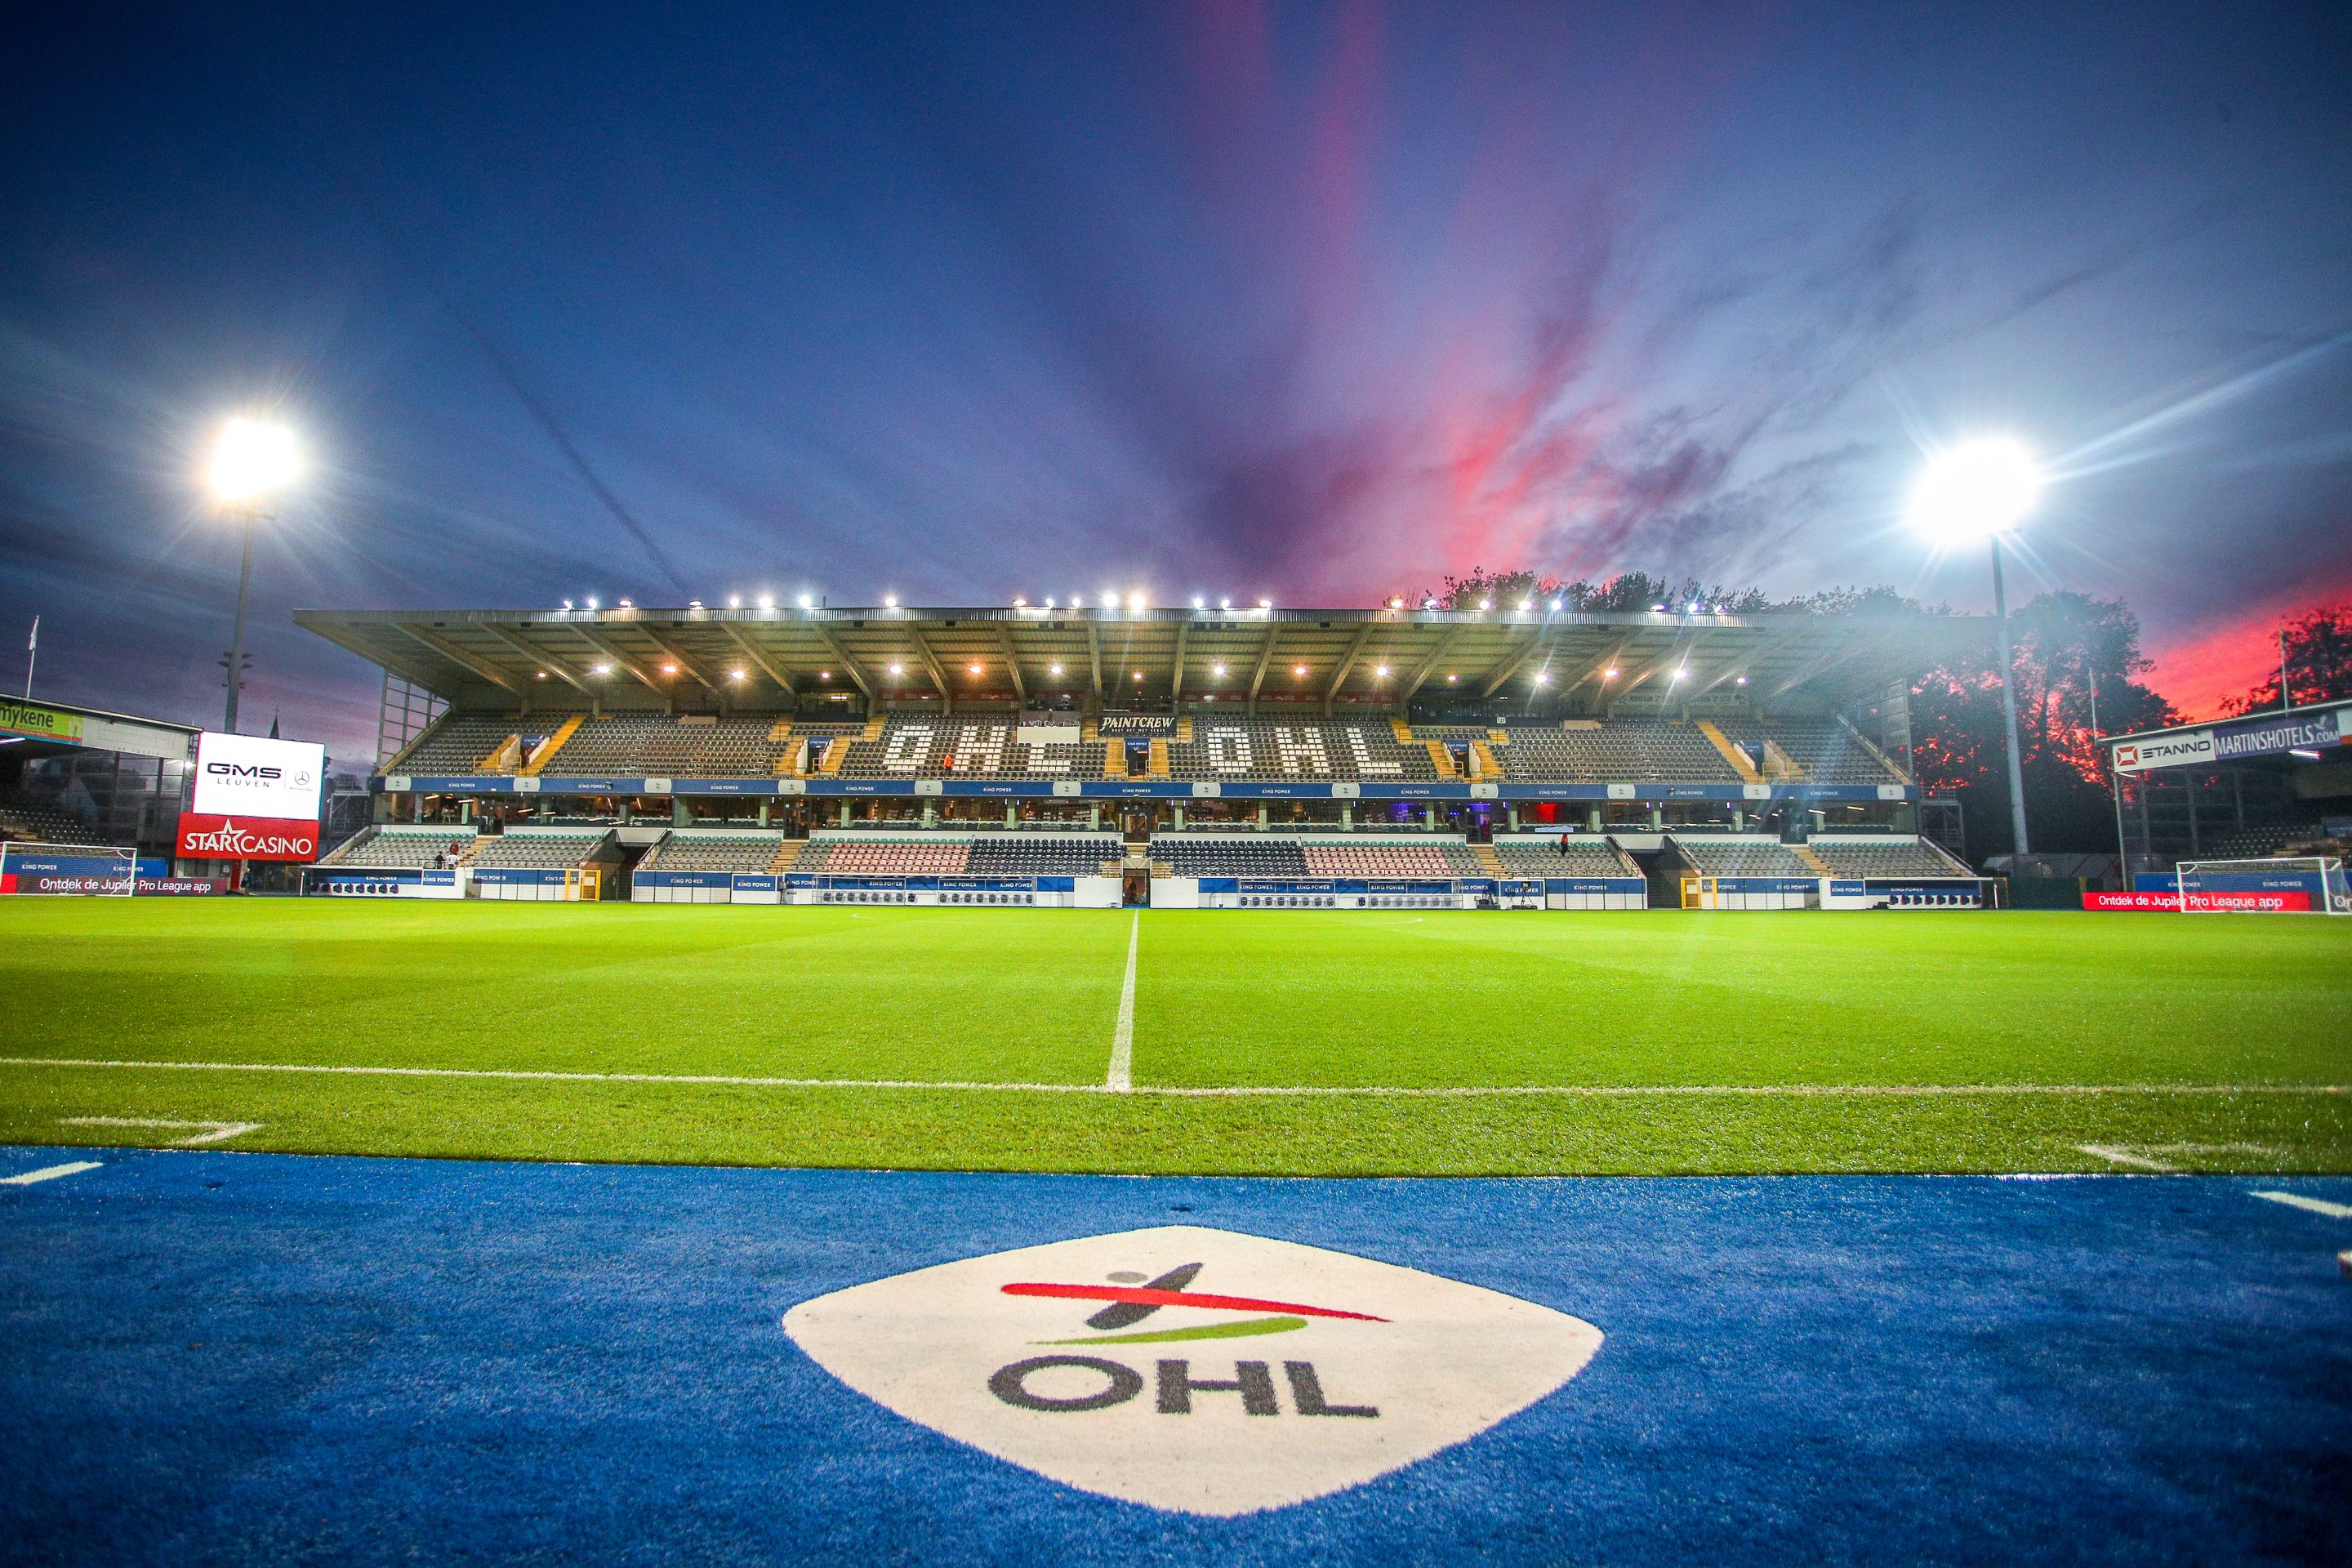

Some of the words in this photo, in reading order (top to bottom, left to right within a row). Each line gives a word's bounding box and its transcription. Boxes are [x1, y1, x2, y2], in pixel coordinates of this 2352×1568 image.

[1099, 717, 1174, 731] PAINTCREW
[2141, 740, 2211, 759] STANNO
[207, 763, 282, 779] GMS
[217, 778, 270, 788] LEUVEN
[40, 878, 82, 889] Ontdek
[85, 879, 98, 889] de
[139, 880, 155, 891] Pro
[158, 880, 192, 893] League
[194, 882, 211, 893] app
[2098, 895, 2133, 906] Ontdek
[2136, 895, 2149, 906] de
[2190, 896, 2209, 906] Pro
[2212, 896, 2255, 908] League
[2258, 898, 2283, 909] app
[988, 1354, 1380, 1417] OHL
